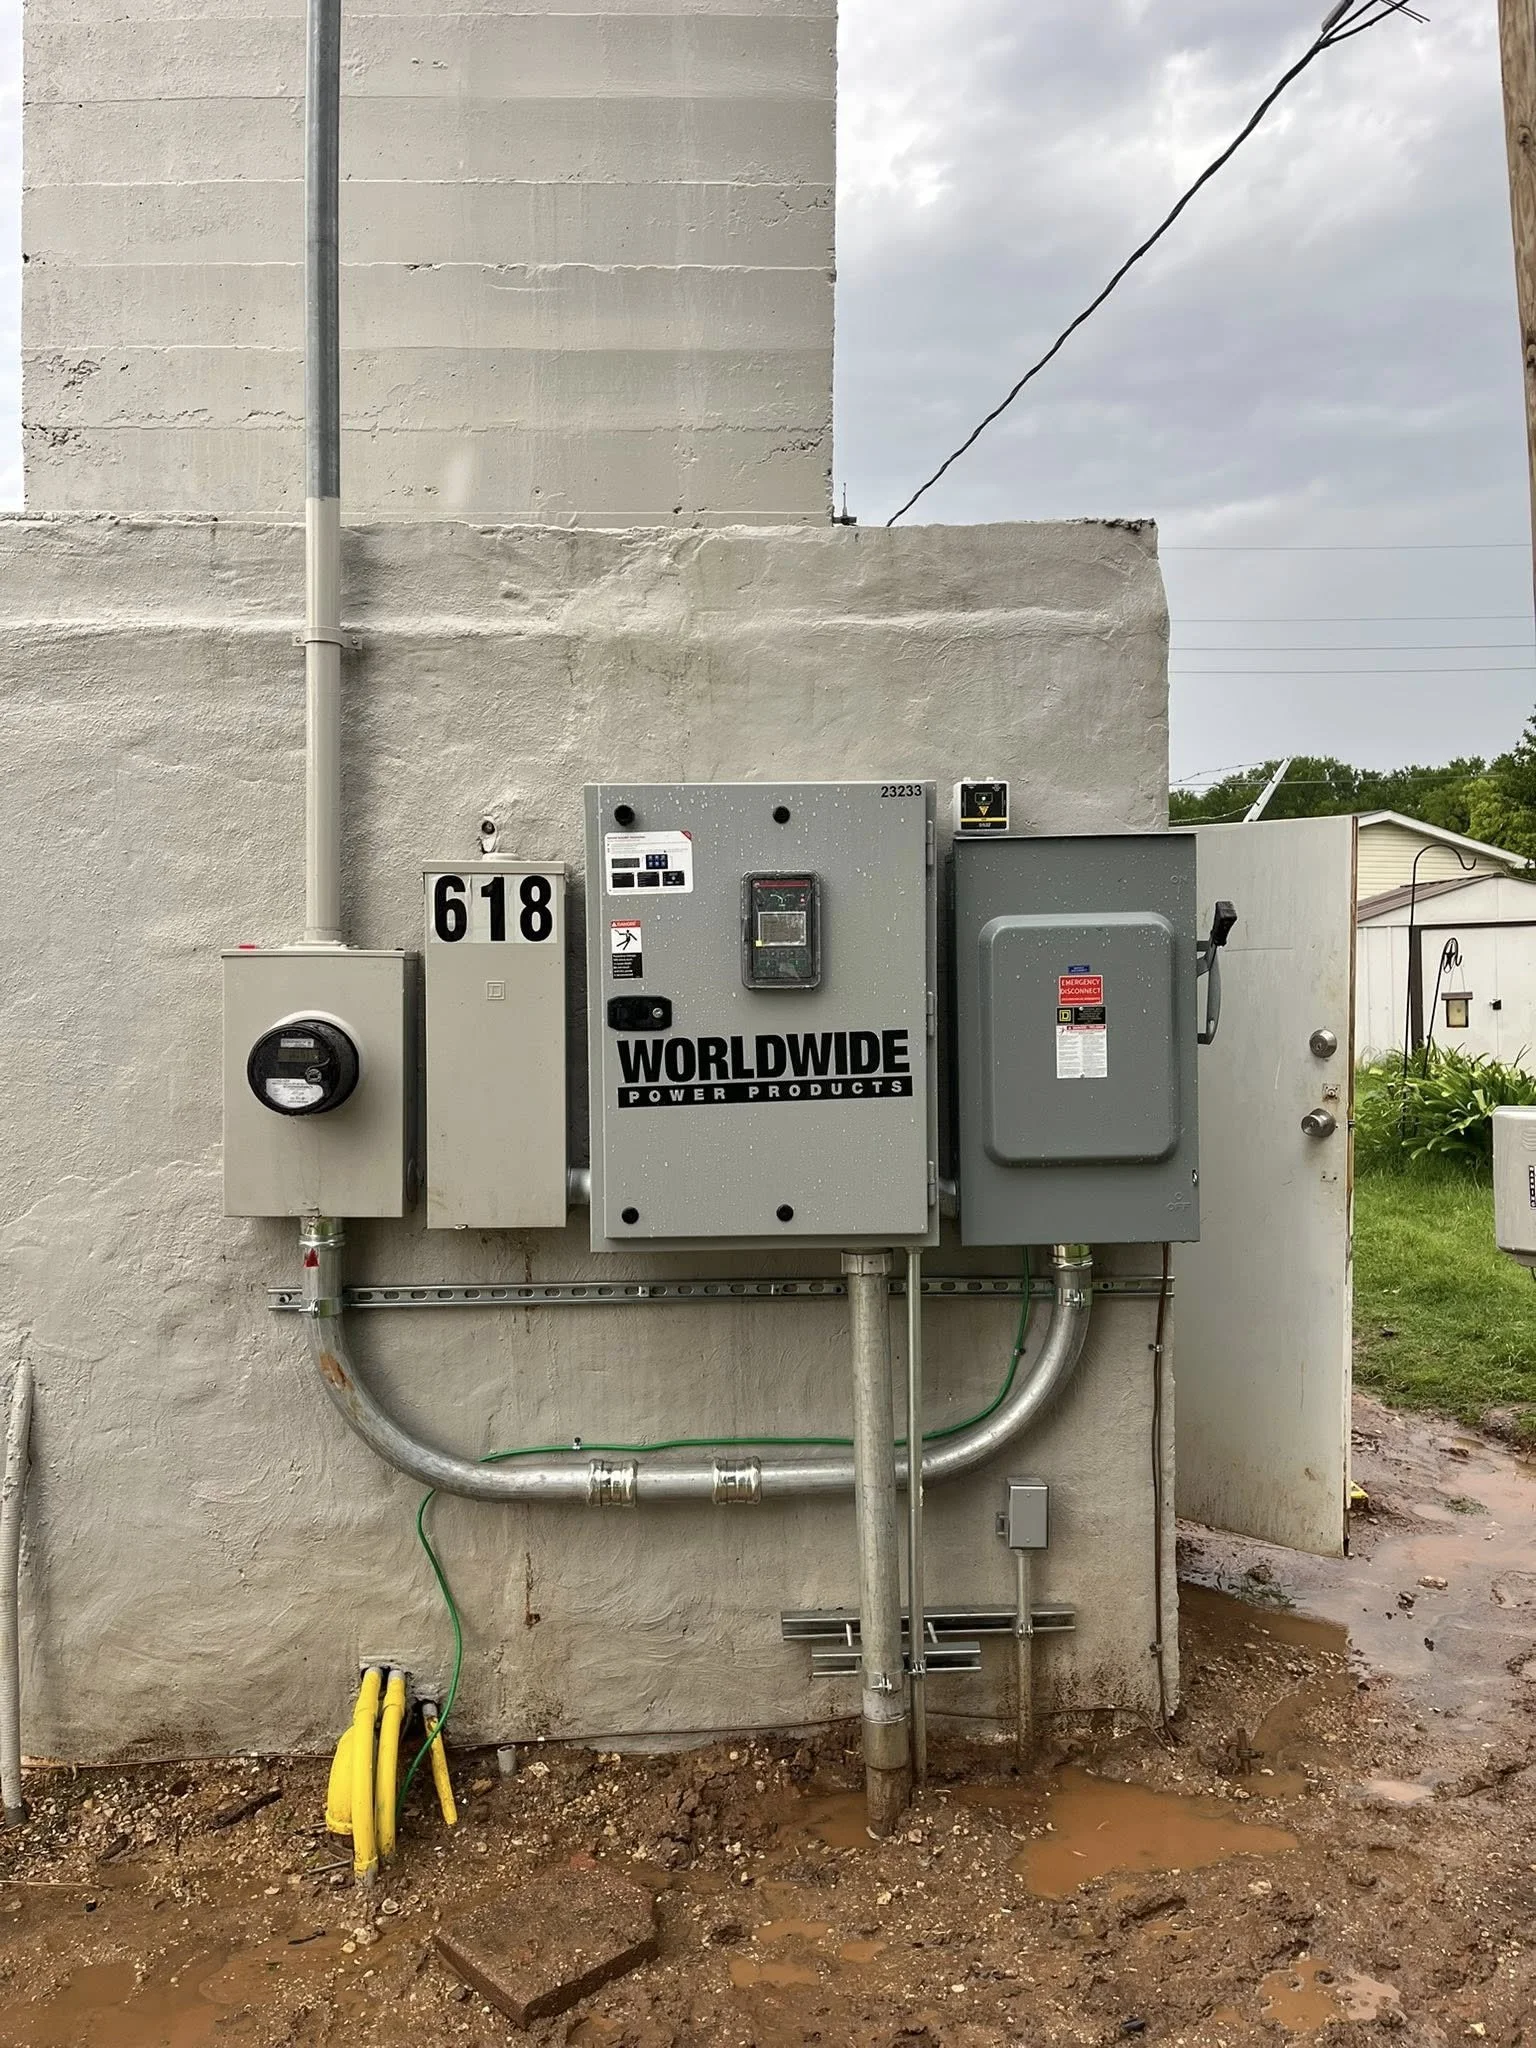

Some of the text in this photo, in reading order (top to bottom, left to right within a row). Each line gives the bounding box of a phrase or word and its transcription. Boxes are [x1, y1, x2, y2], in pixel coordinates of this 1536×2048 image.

[881, 784, 922, 798] 23233
[434, 875, 553, 942] 618
[1060, 987, 1101, 995] DISCONNECT
[1061, 978, 1101, 986] EMERGENCY
[617, 1029, 910, 1084] WORLDWIDE
[628, 1081, 902, 1104] POWER PRODUCTS
